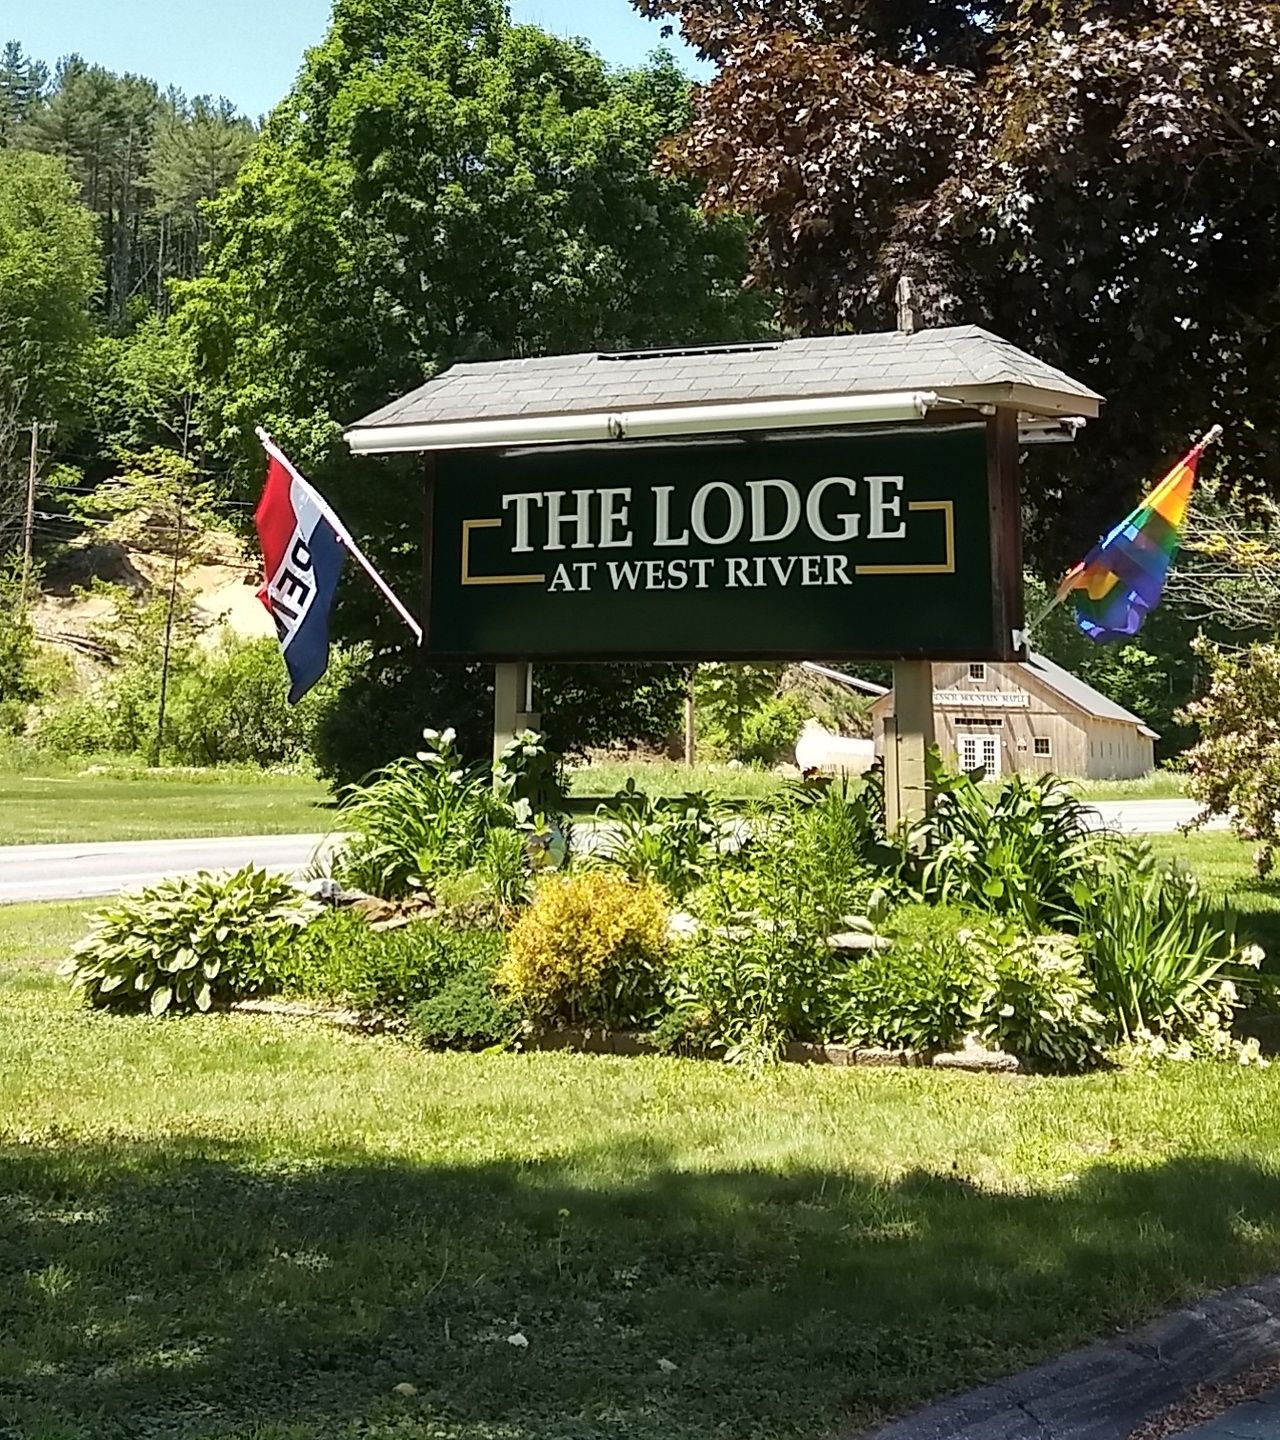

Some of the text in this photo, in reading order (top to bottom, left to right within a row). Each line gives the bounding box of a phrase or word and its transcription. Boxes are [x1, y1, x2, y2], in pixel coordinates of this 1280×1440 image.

[502, 475, 907, 553] THE LODGE
[547, 554, 853, 592] AT WEST RIVER
[960, 694, 998, 703] MOUNTAIN
